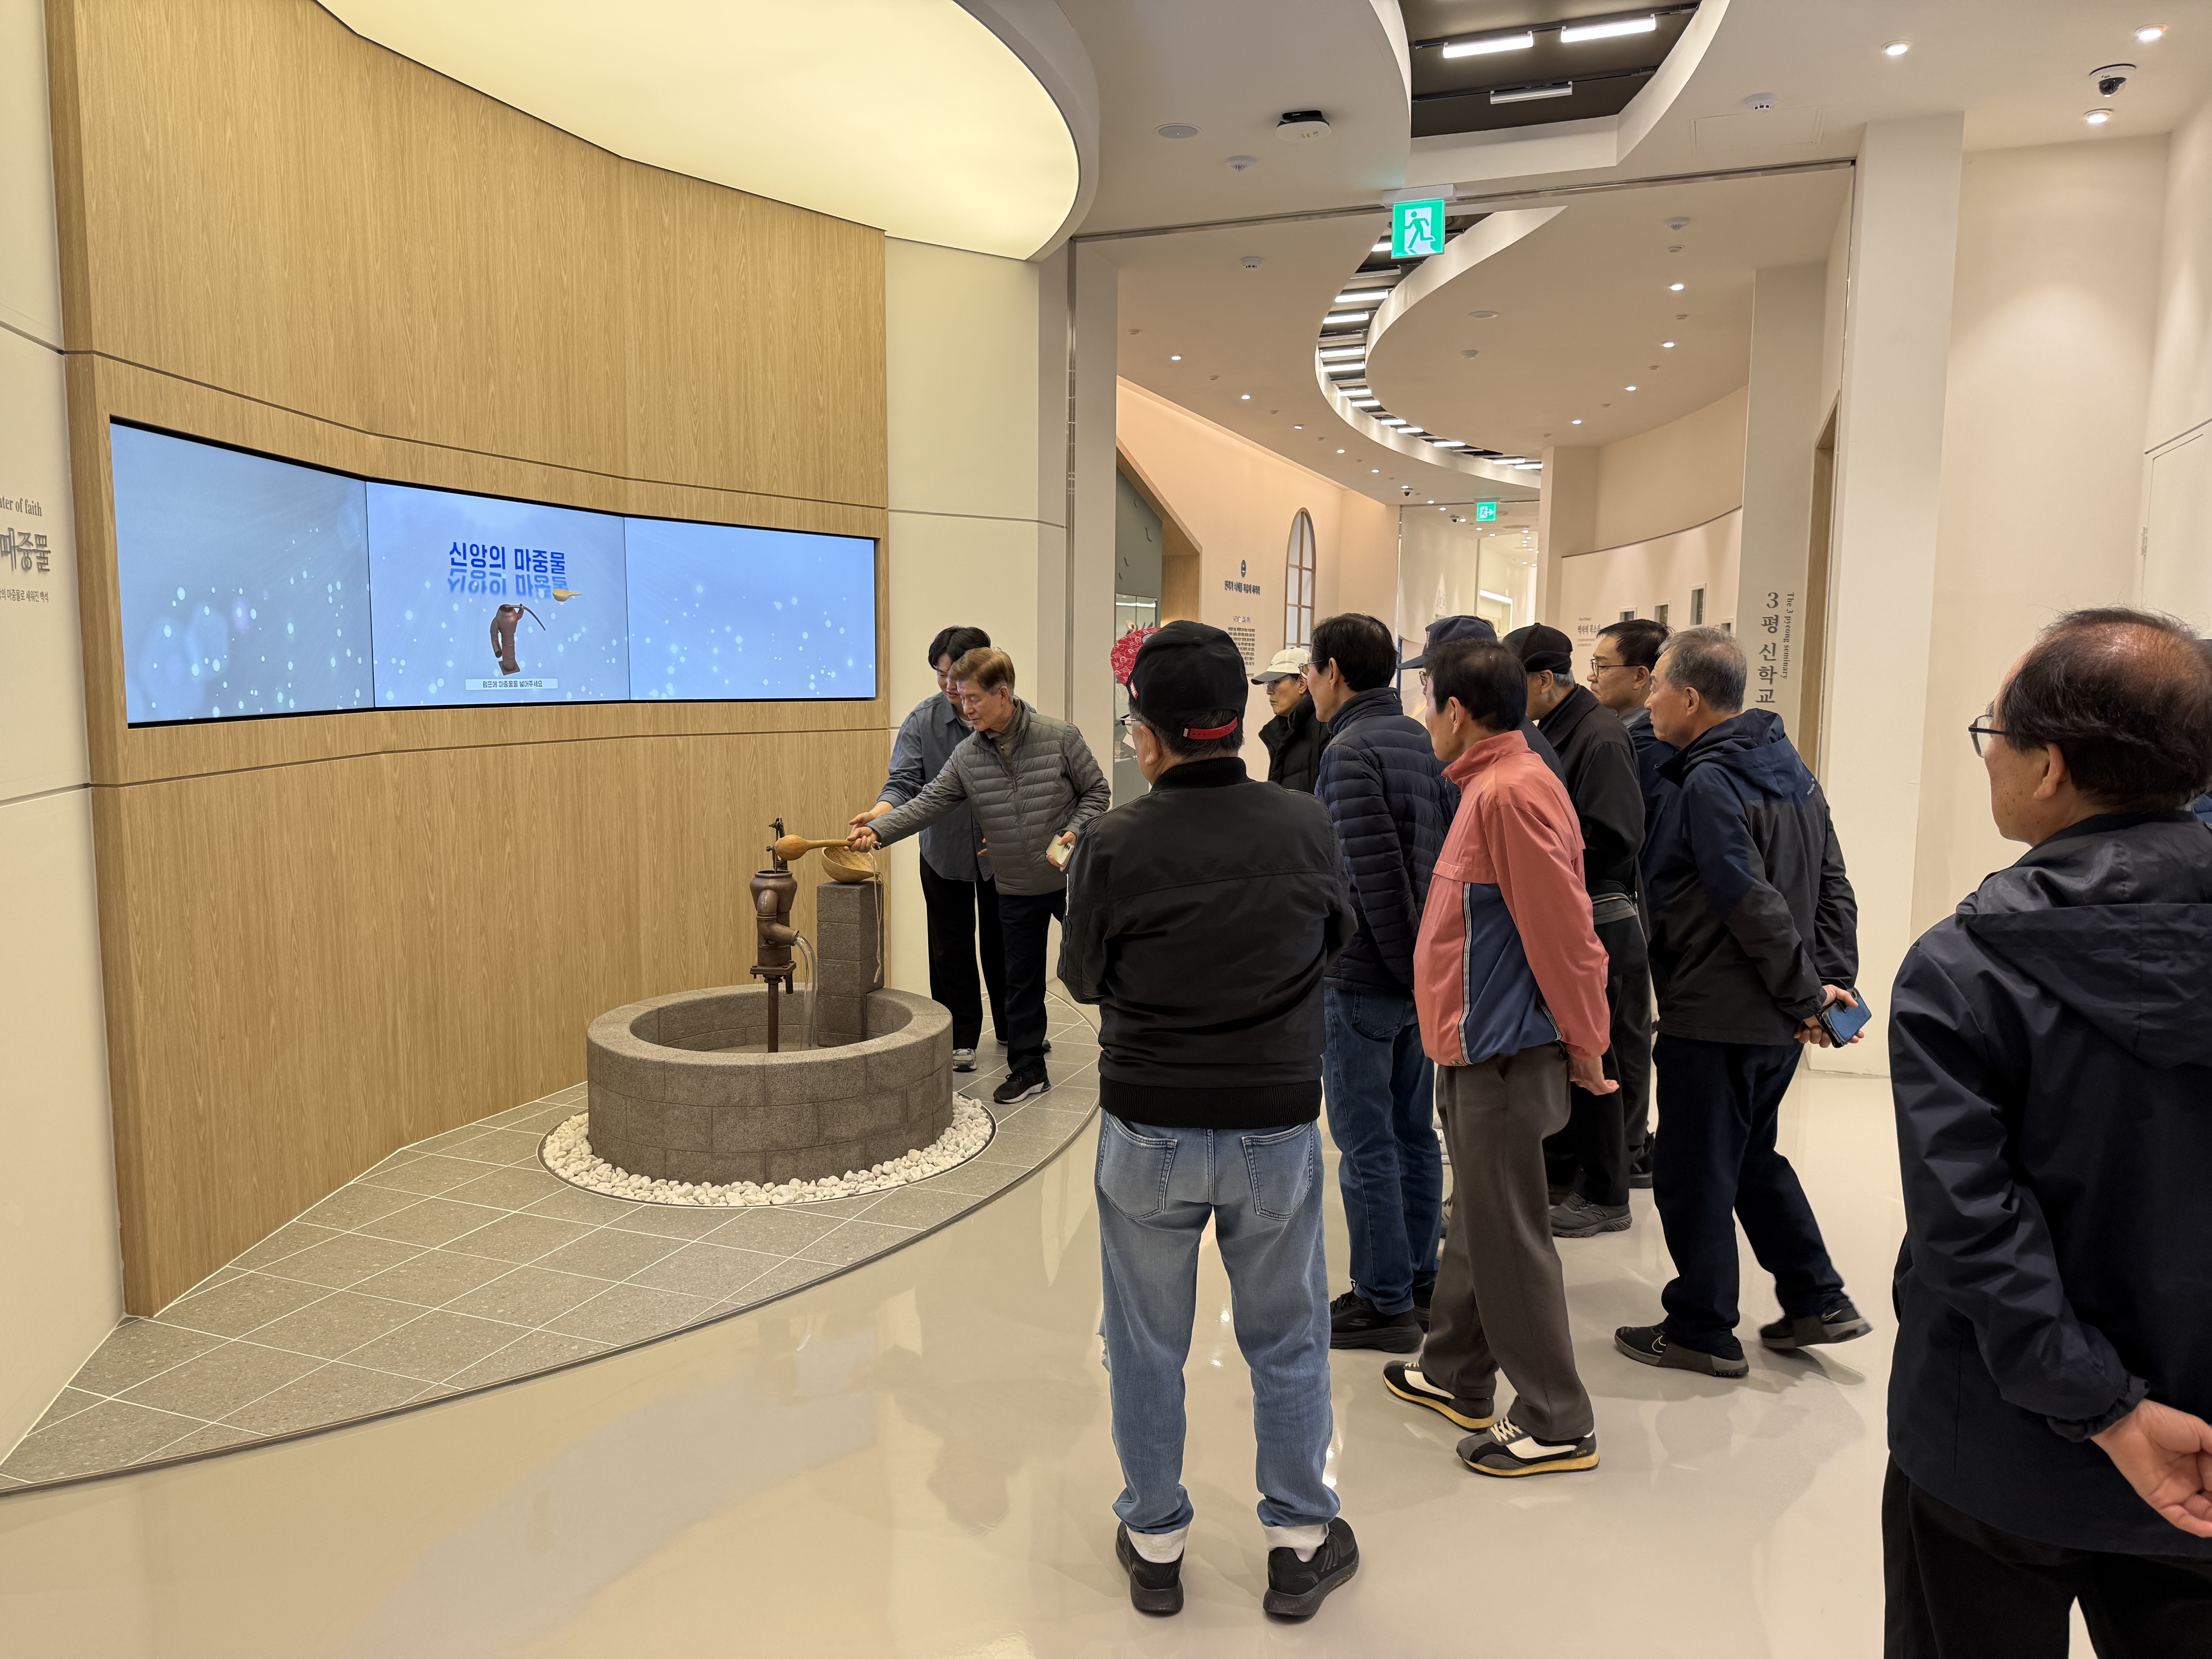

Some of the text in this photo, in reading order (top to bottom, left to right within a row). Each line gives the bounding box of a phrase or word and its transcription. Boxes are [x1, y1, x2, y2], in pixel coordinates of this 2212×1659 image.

[15, 498, 23, 512] of
[25, 499, 42, 517] faith
[450, 542, 565, 575] 신앙의 마중물
[7, 589, 25, 601] 마중물로
[26, 590, 39, 602] 세워진
[1786, 592, 1795, 607] The
[1783, 616, 1791, 642] pyeong
[1780, 645, 1790, 679] seminary
